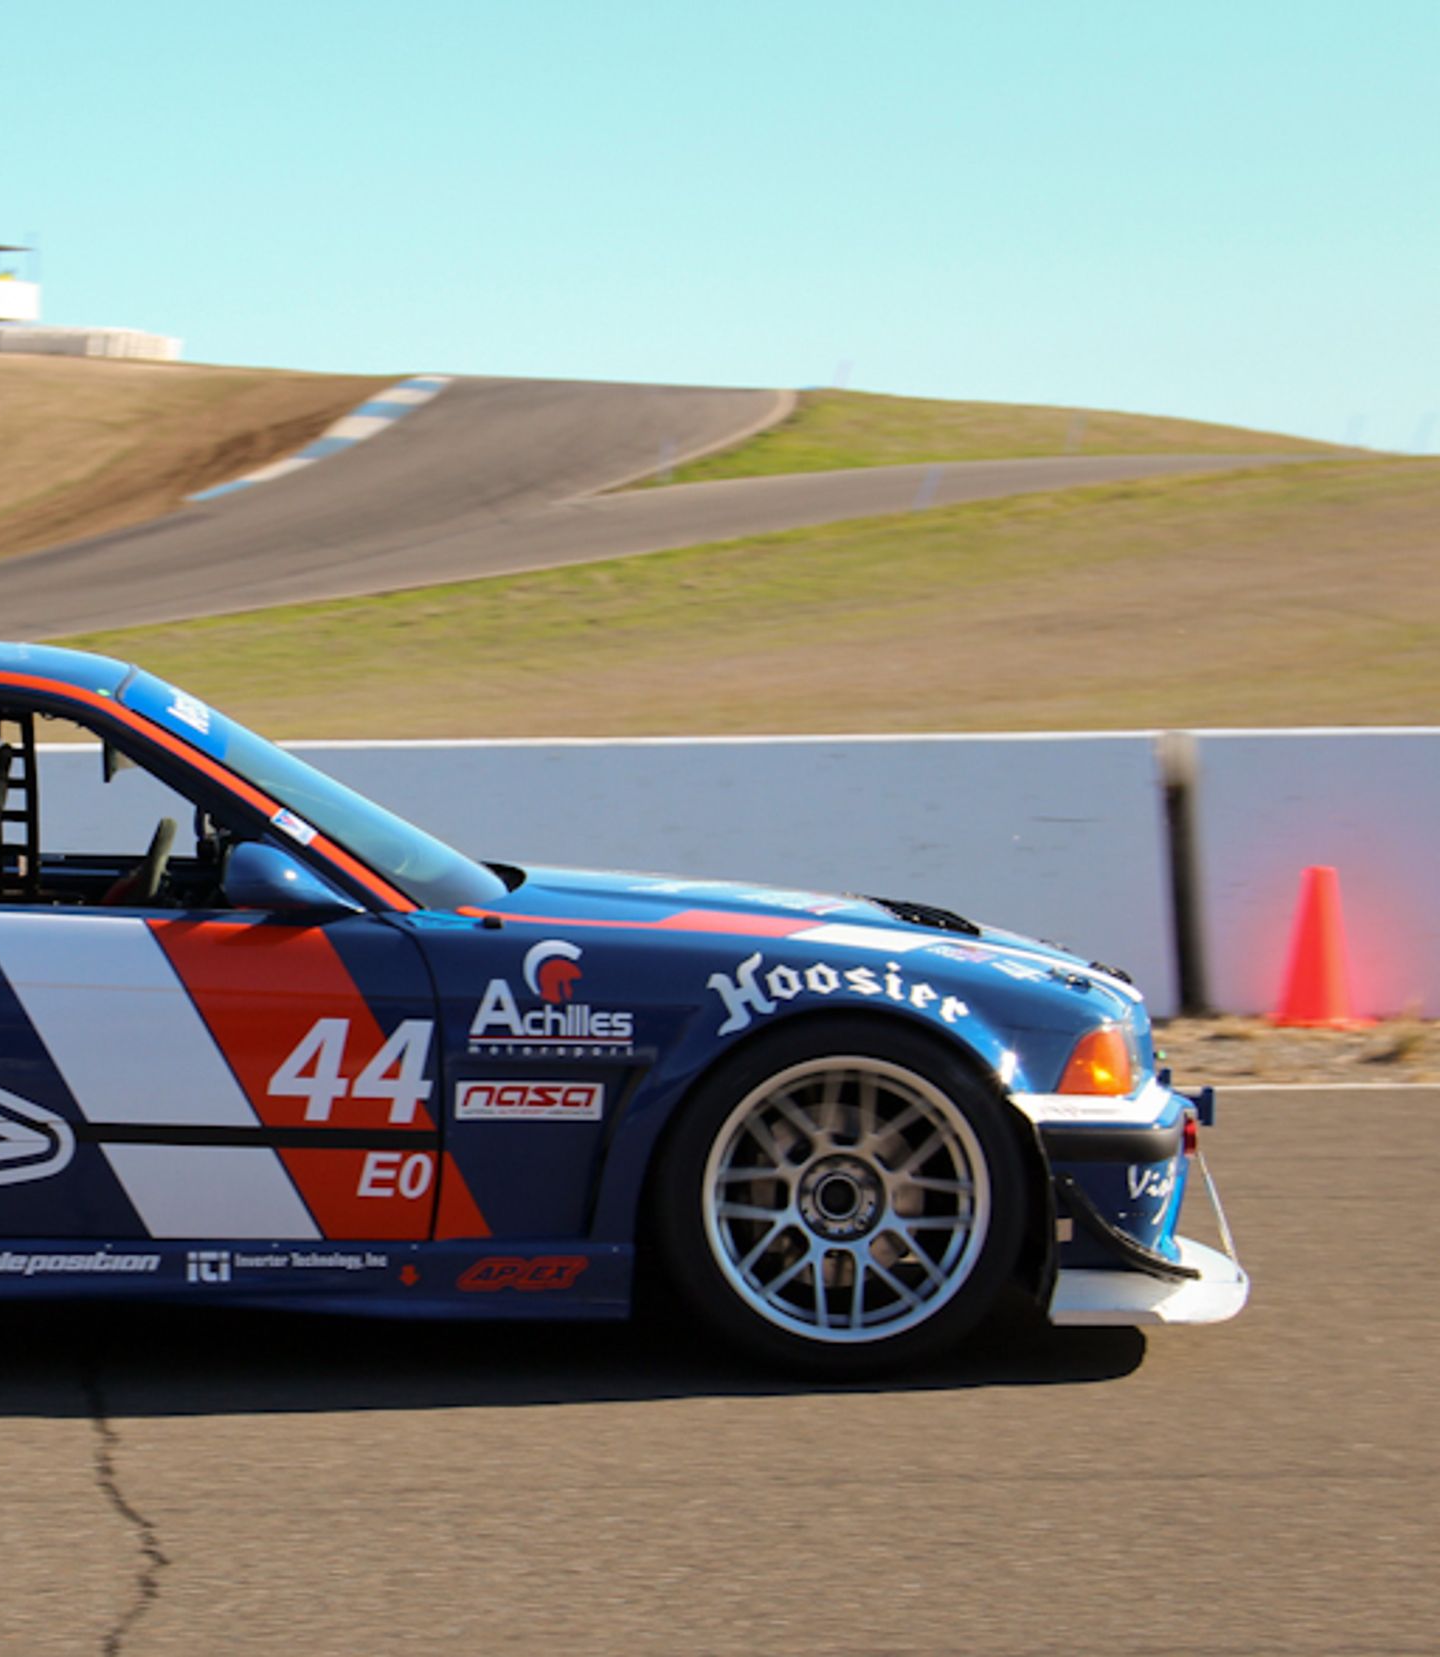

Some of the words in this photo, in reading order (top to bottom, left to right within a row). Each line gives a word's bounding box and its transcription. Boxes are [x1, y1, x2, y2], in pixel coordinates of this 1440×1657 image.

[469, 979, 634, 1037] Achilles
[708, 952, 970, 1036] Hoosier
[267, 1017, 435, 1124] 44
